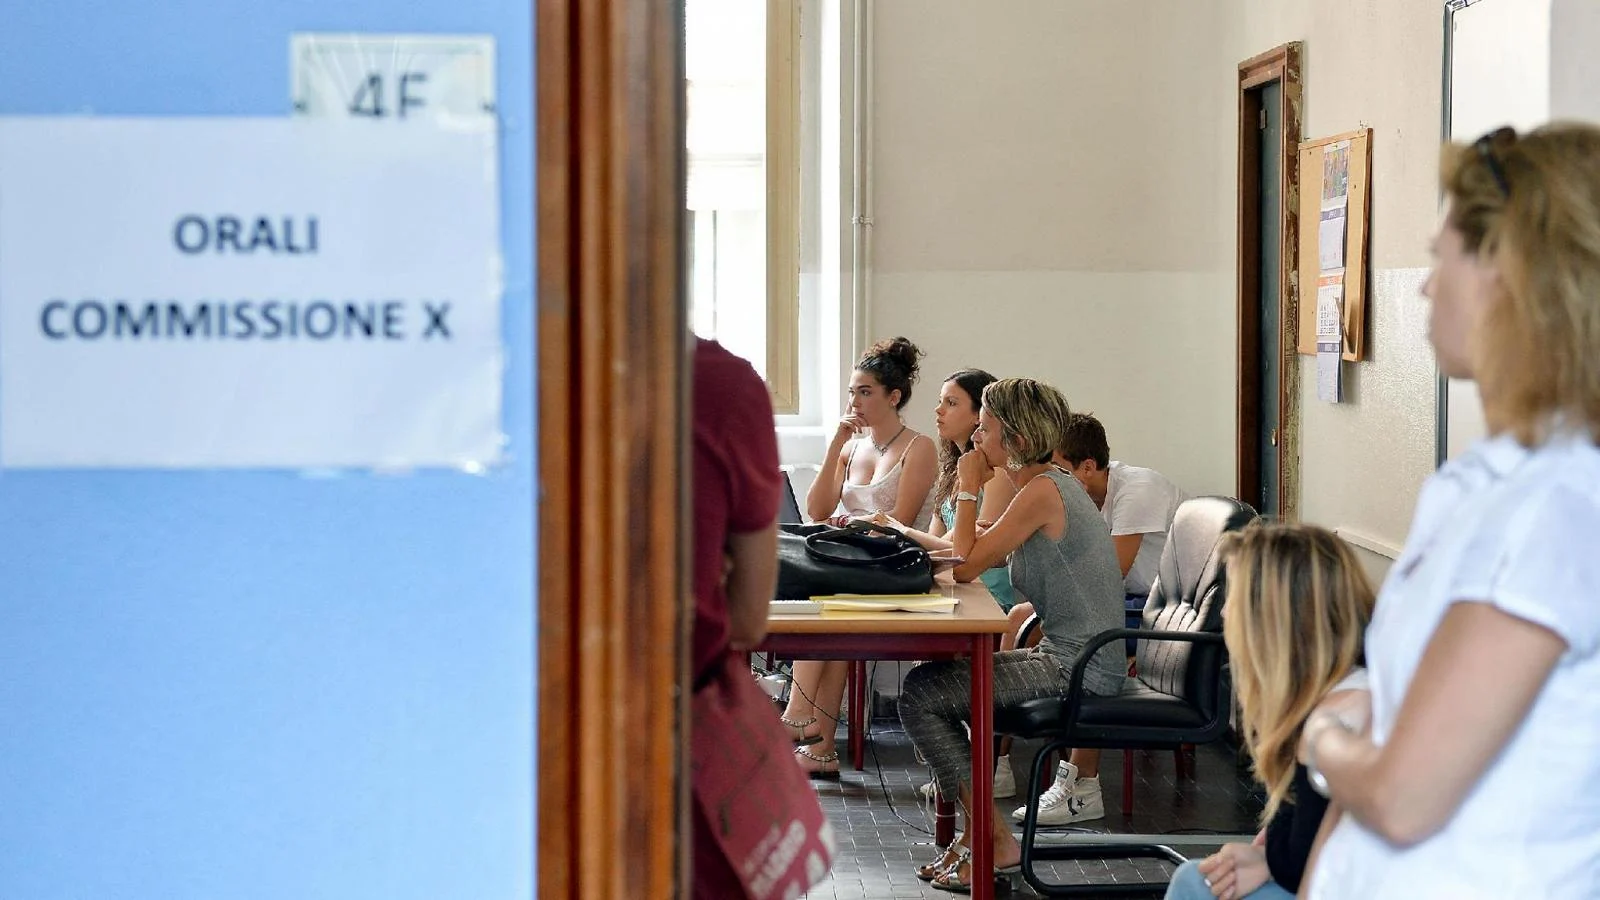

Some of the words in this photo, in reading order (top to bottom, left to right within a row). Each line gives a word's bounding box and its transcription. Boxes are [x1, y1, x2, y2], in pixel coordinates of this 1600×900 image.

[173, 215, 319, 254] ORALI
[39, 300, 404, 339] COMMISSIONE
[423, 302, 452, 339] X
